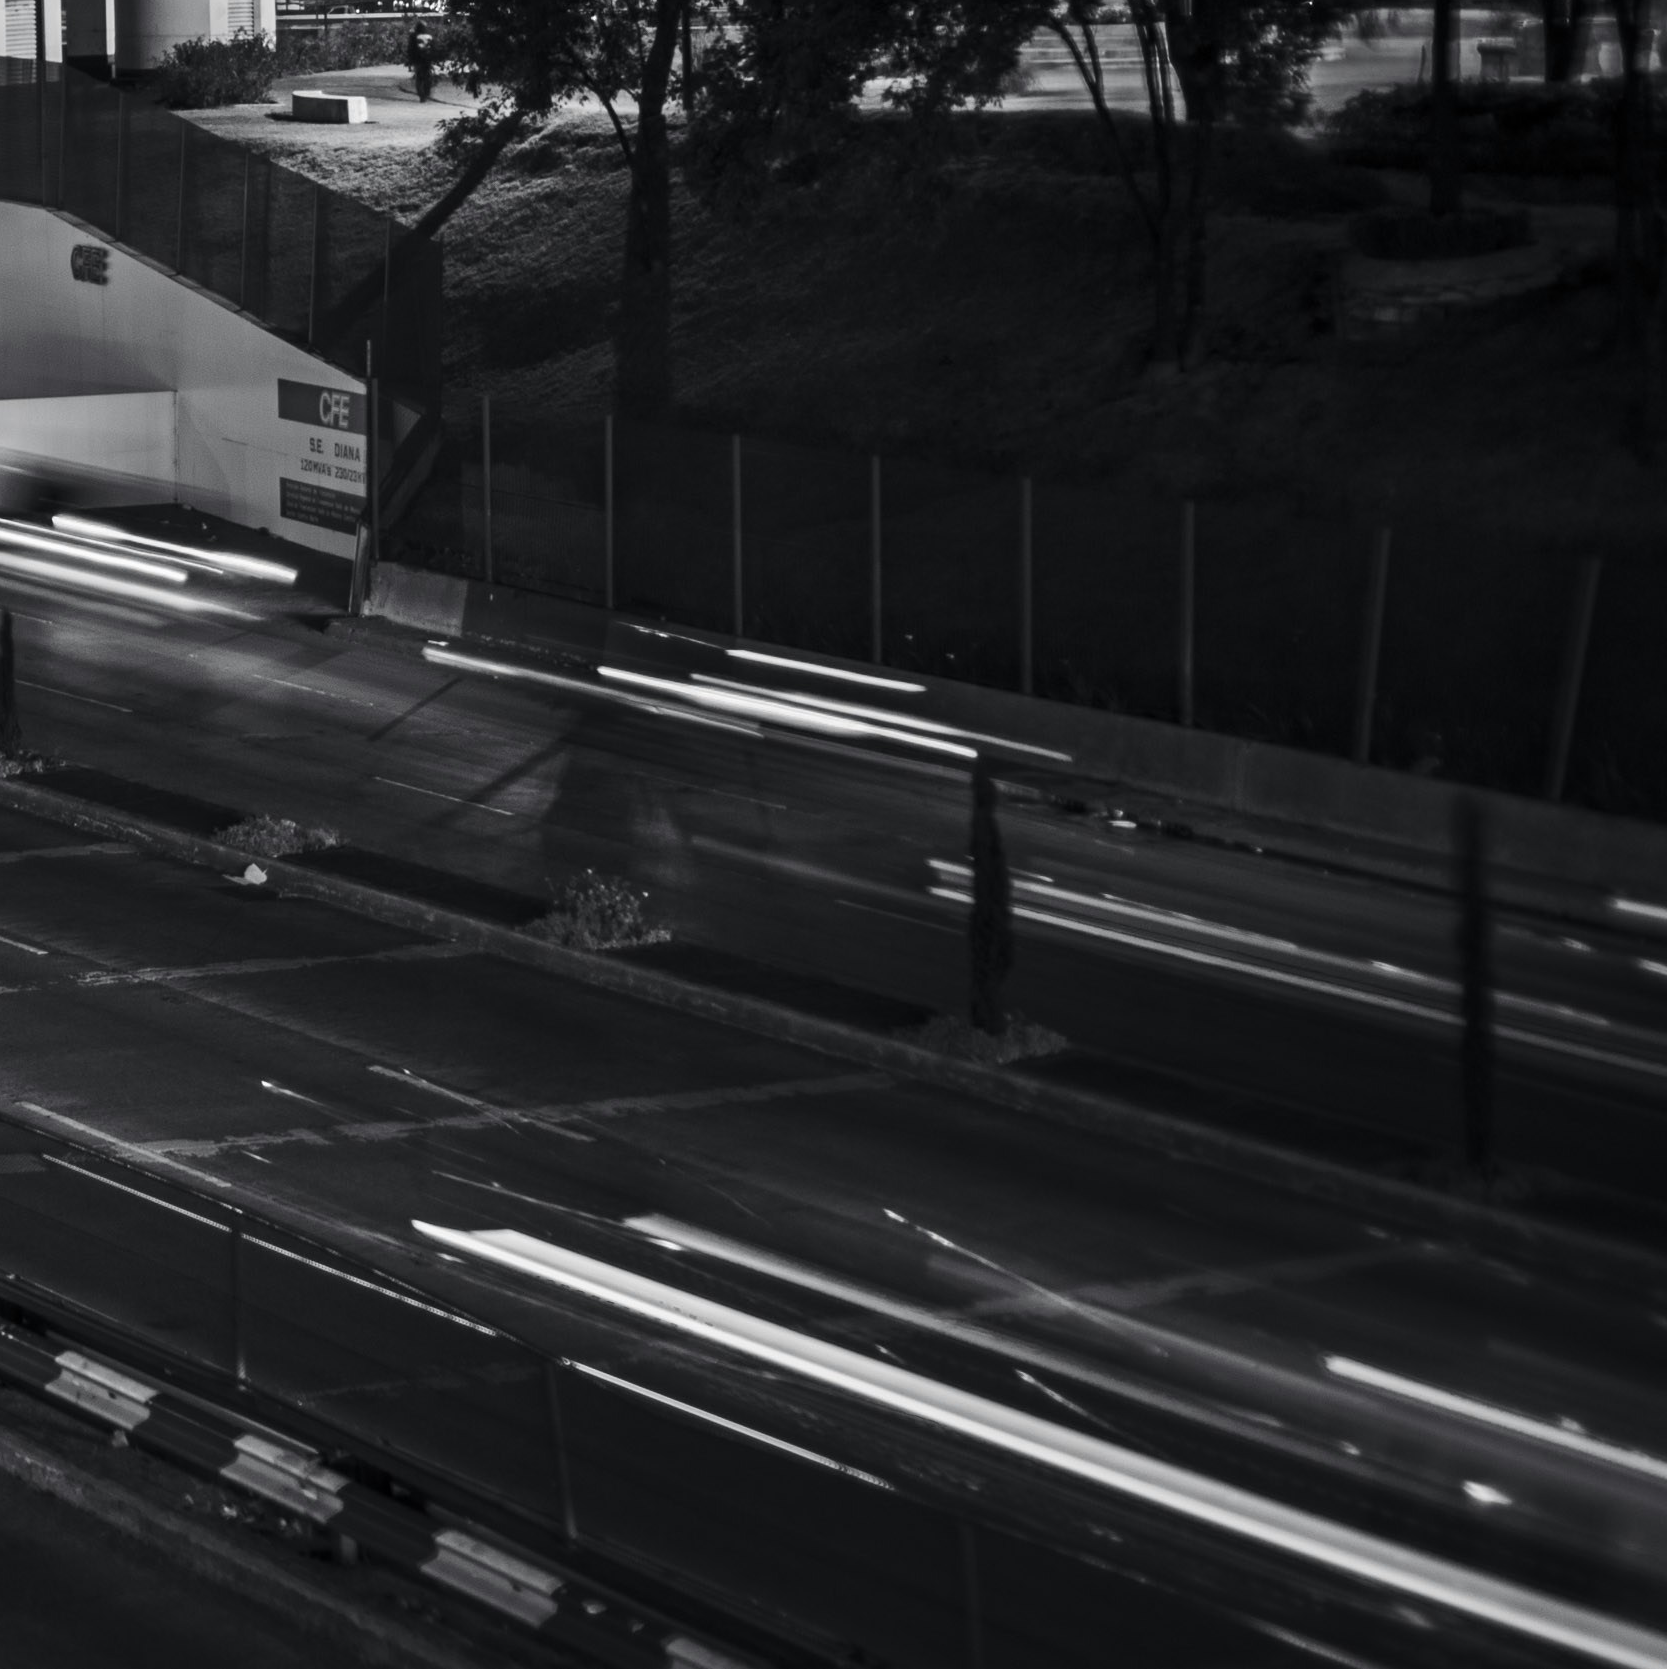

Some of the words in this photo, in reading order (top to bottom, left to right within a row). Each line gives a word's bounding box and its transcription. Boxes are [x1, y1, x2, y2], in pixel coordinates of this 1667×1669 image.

[71, 244, 109, 286] CFE
[319, 390, 350, 429] CFE
[334, 442, 361, 462] DIANA
